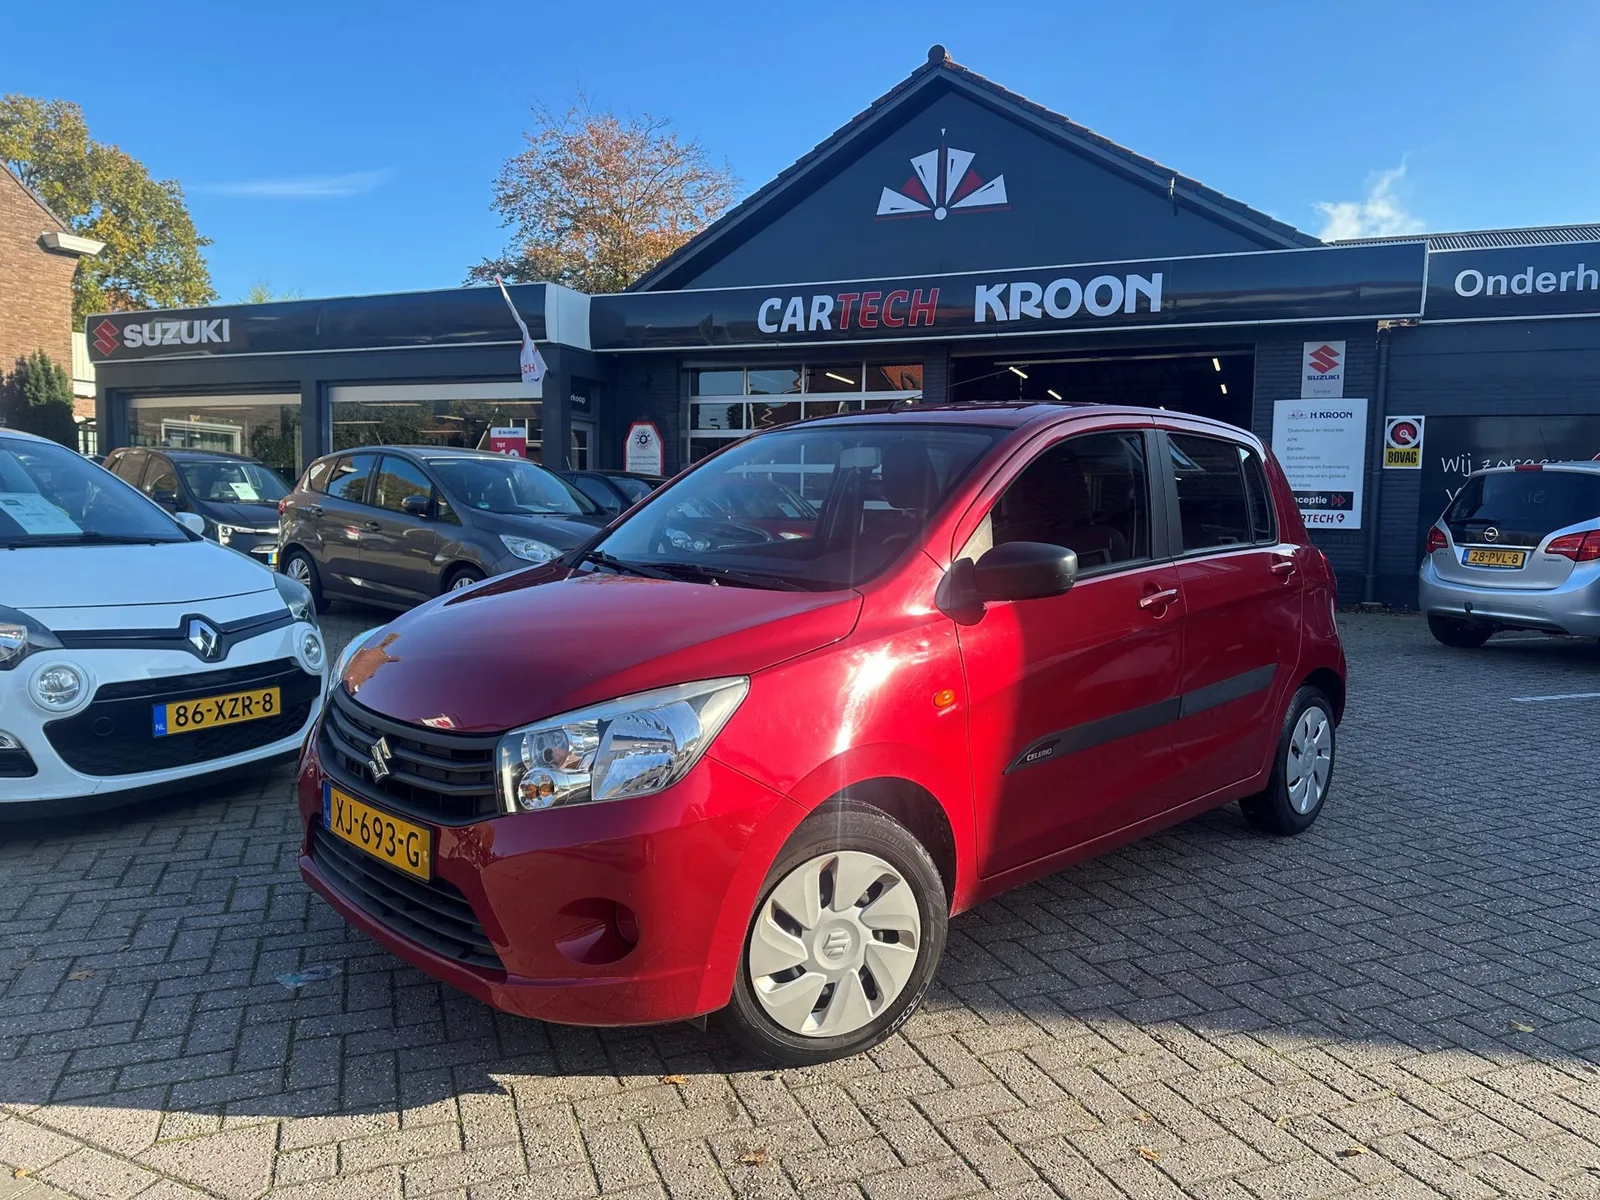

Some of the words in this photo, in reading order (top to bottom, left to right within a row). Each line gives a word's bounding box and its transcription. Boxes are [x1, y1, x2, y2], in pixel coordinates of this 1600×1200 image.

[1454, 263, 1599, 297] Onderh
[757, 288, 940, 333] CARTECH
[974, 272, 1163, 323] KROON
[123, 318, 230, 348] SUZUKI
[1388, 451, 1417, 464] BOVAG
[1441, 453, 1471, 477] Wij
[1471, 551, 1519, 564] 28-PVL-8
[175, 692, 274, 727] 86-XZR-8
[155, 723, 165, 731] NL
[1026, 747, 1053, 762] CELERIO
[335, 796, 420, 868] XJ-693-G
